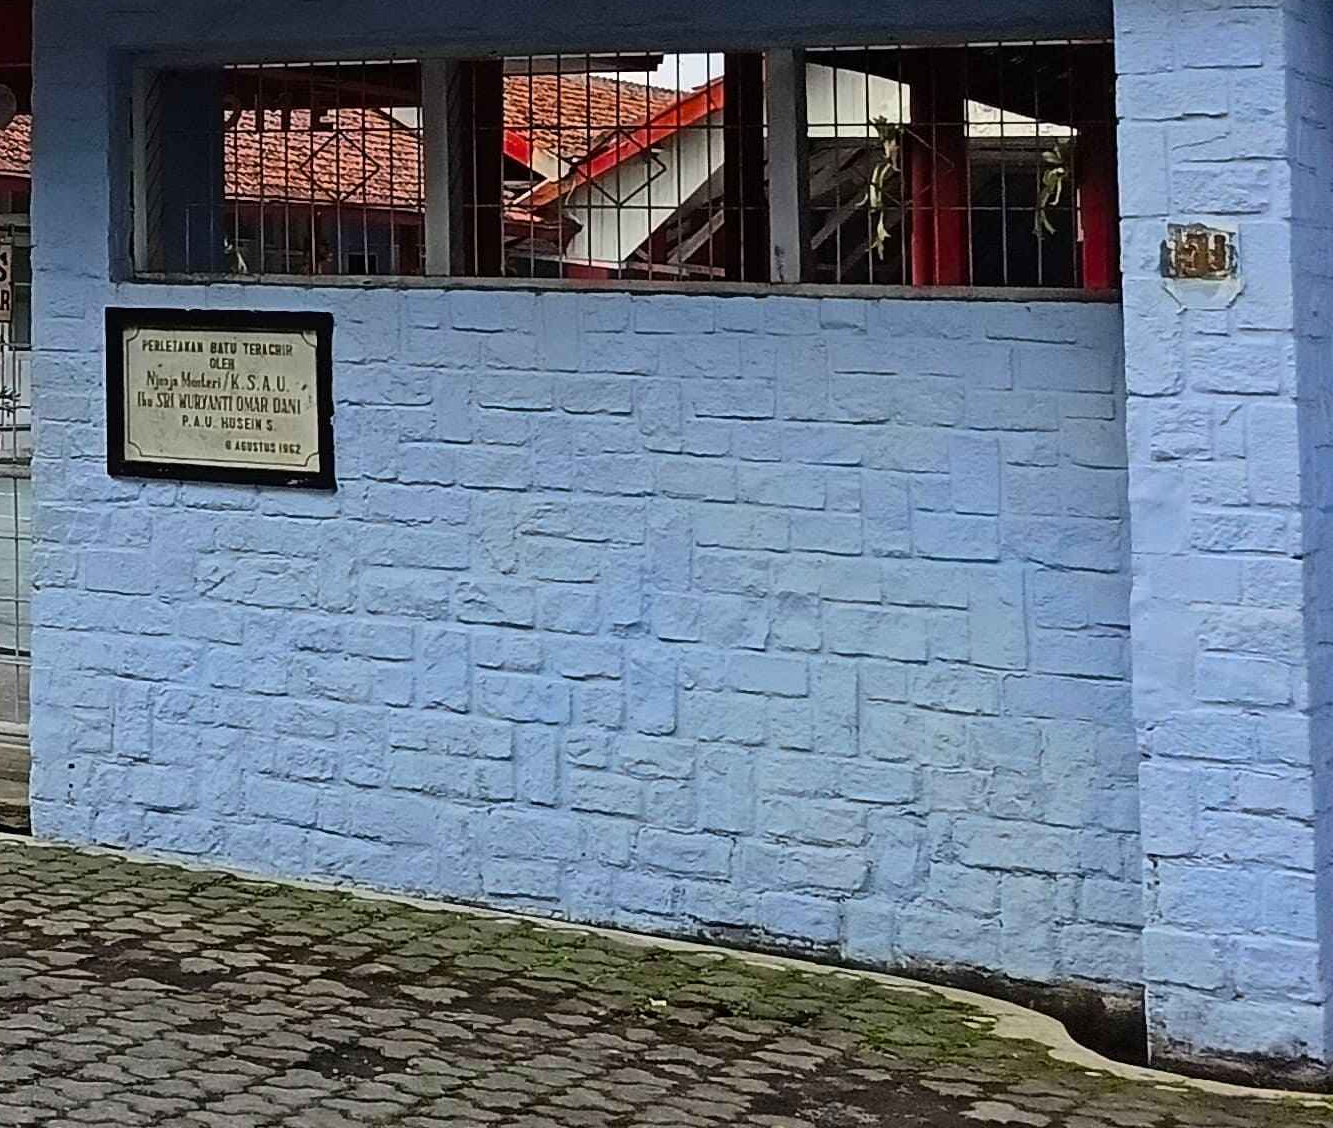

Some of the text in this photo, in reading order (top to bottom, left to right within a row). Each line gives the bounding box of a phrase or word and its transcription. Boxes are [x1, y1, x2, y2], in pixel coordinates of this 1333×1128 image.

[142, 339, 293, 356] PERLETAKAN BATU TERACHIR
[209, 357, 235, 370] OLEH
[156, 392, 174, 409] SRI
[236, 395, 268, 413] OMAR
[273, 397, 301, 415] DANI
[221, 417, 261, 431] HUSEIN
[235, 441, 276, 453] AGUSTUS
